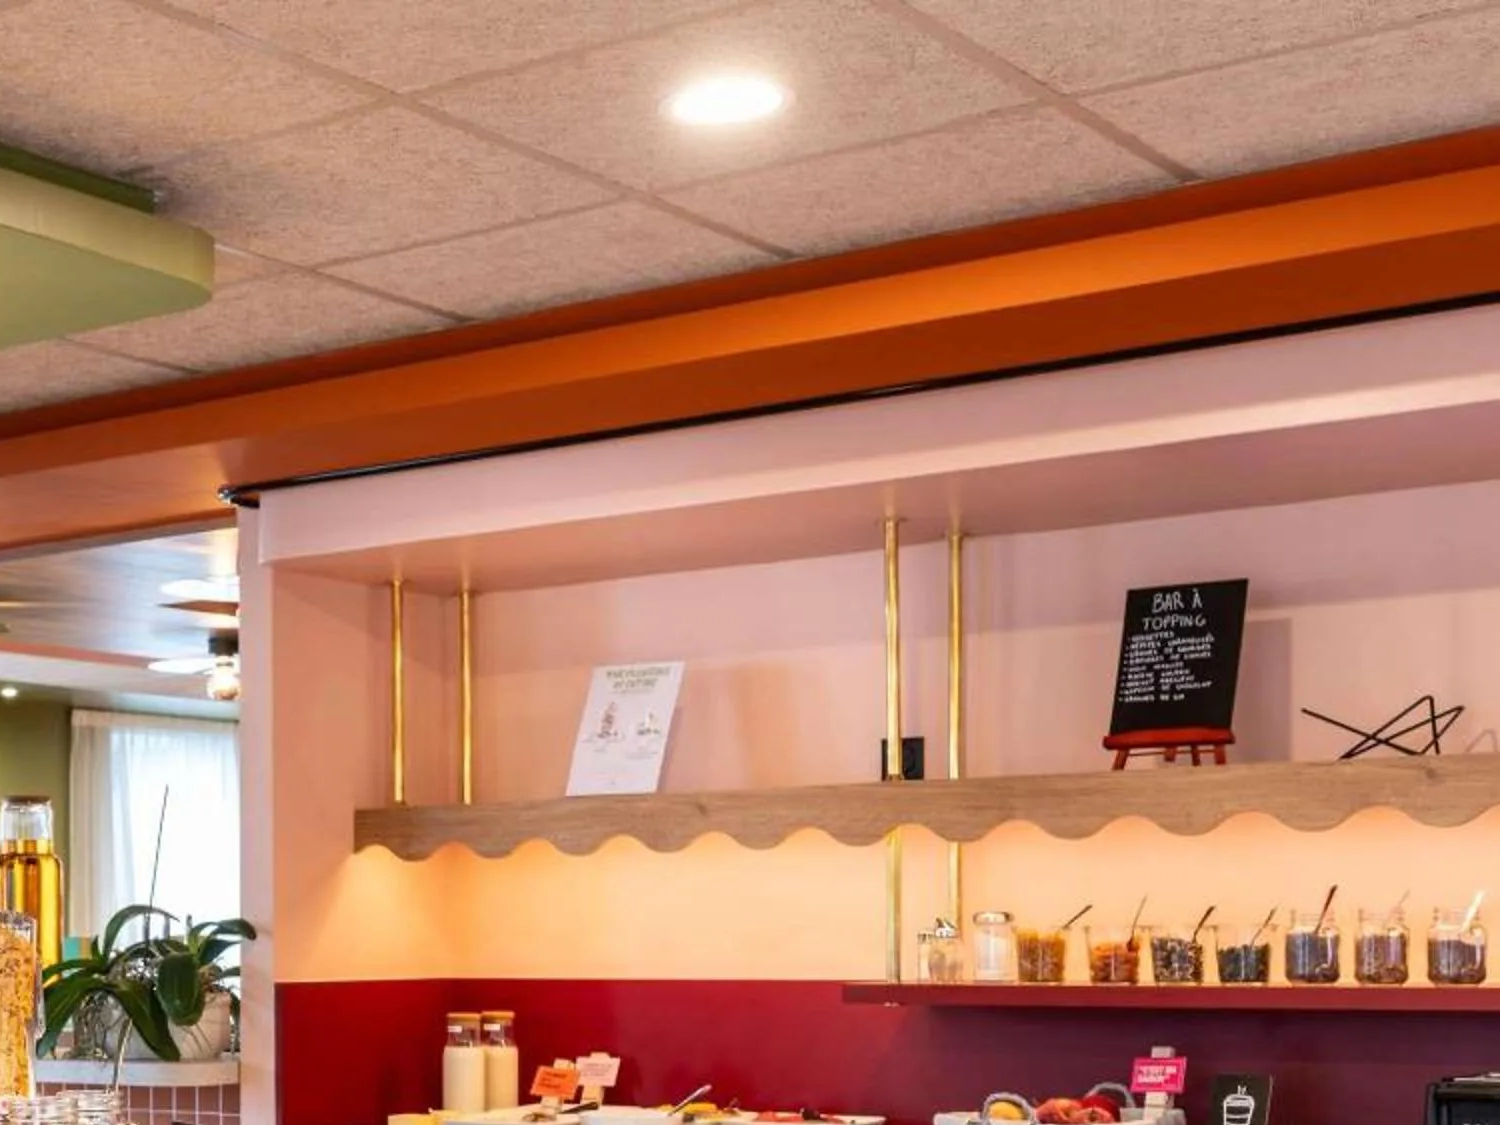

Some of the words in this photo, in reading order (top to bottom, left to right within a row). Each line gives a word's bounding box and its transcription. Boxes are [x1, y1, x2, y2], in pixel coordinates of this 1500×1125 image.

[1152, 591, 1185, 613] BAR
[1191, 588, 1203, 608] À
[1142, 614, 1206, 630] TOPPING
